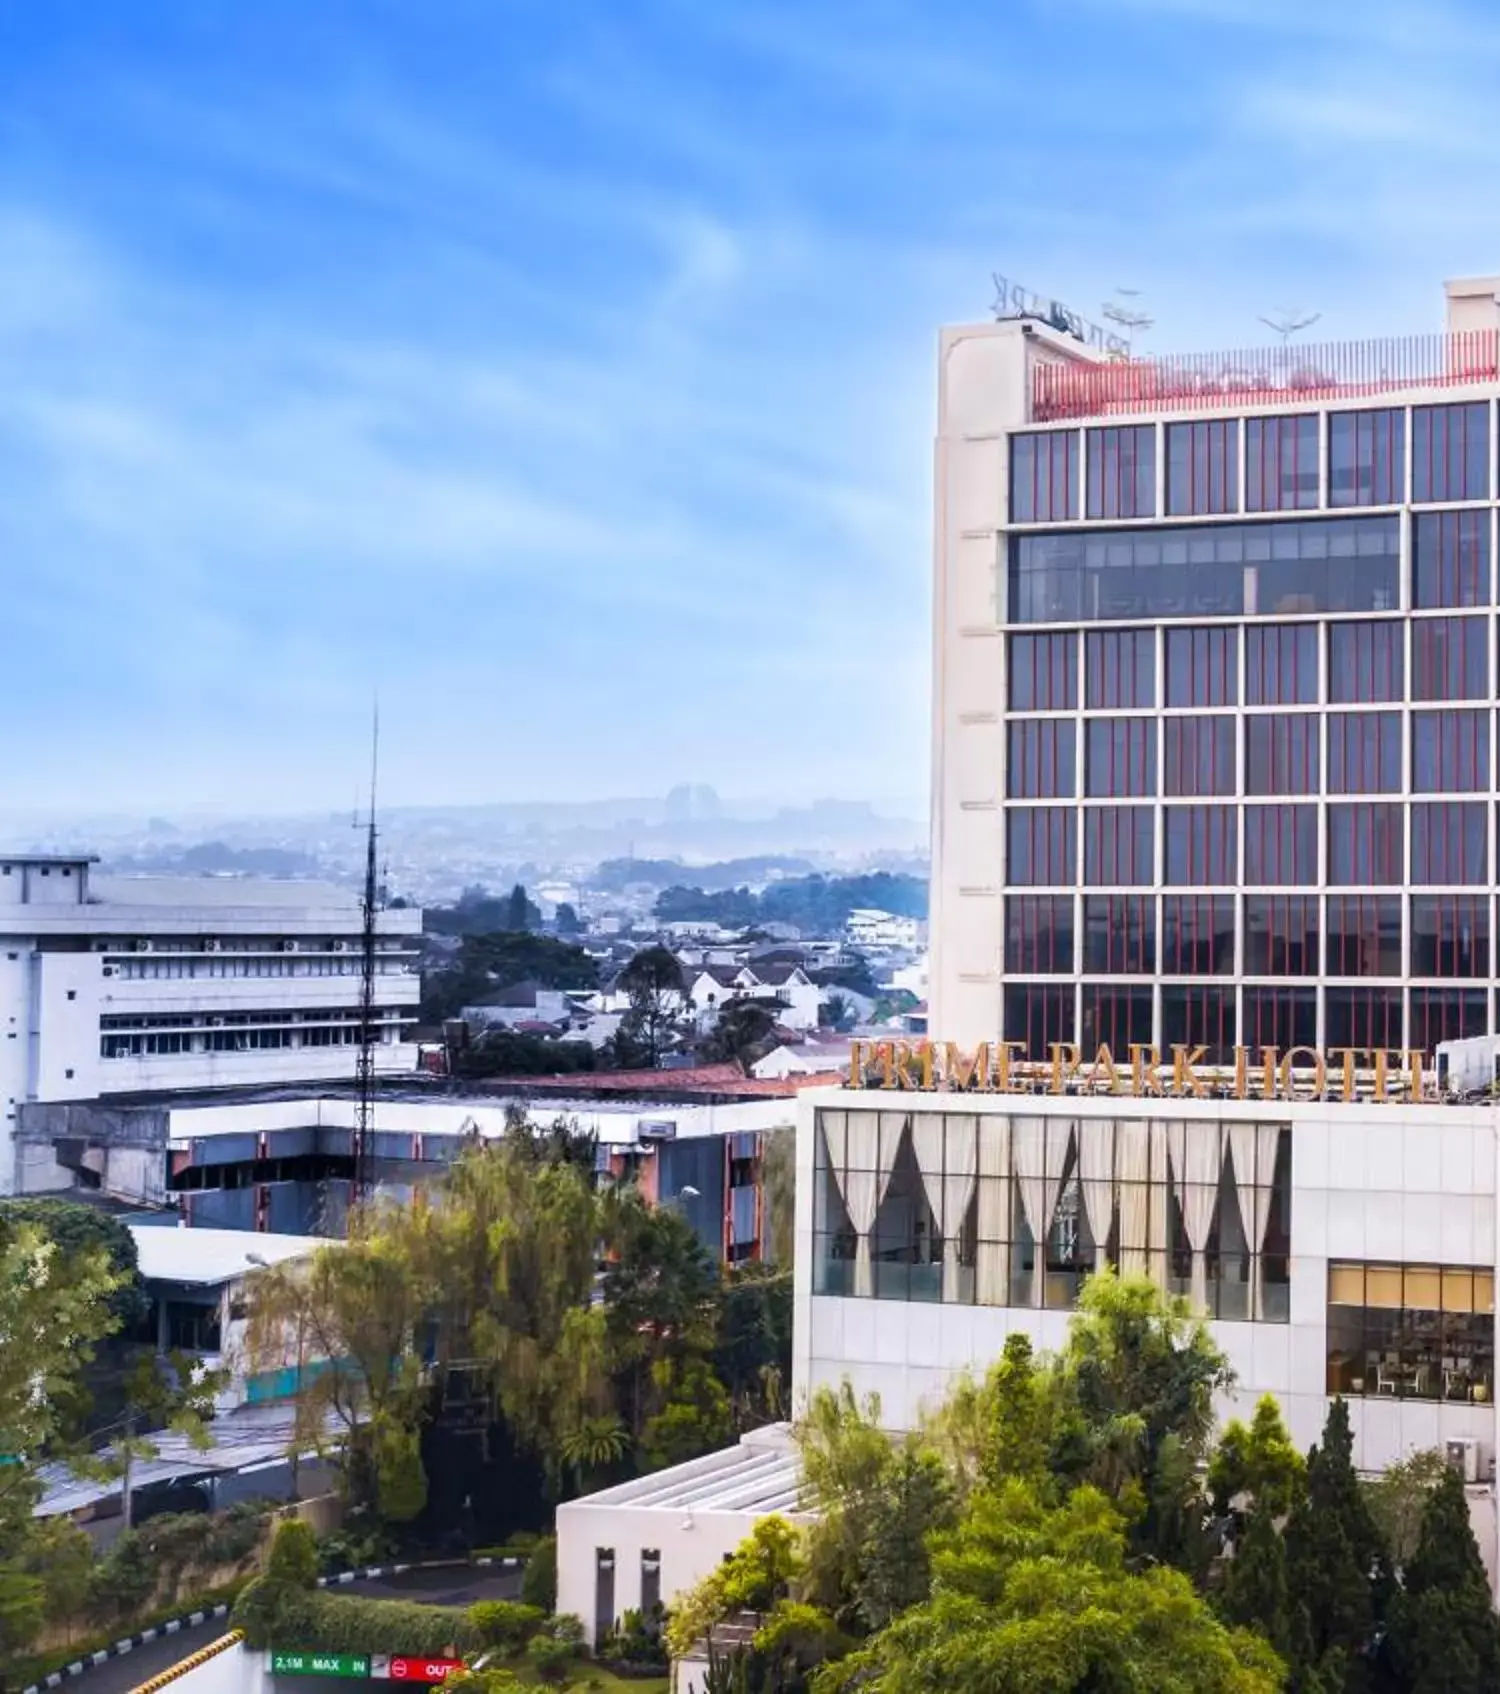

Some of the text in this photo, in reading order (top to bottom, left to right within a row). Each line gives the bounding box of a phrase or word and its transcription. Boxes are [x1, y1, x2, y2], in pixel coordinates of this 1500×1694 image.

[847, 1037, 1440, 1103] PRIME PARK HOTEL
[312, 1658, 340, 1671] MAX
[353, 1661, 365, 1672] IN
